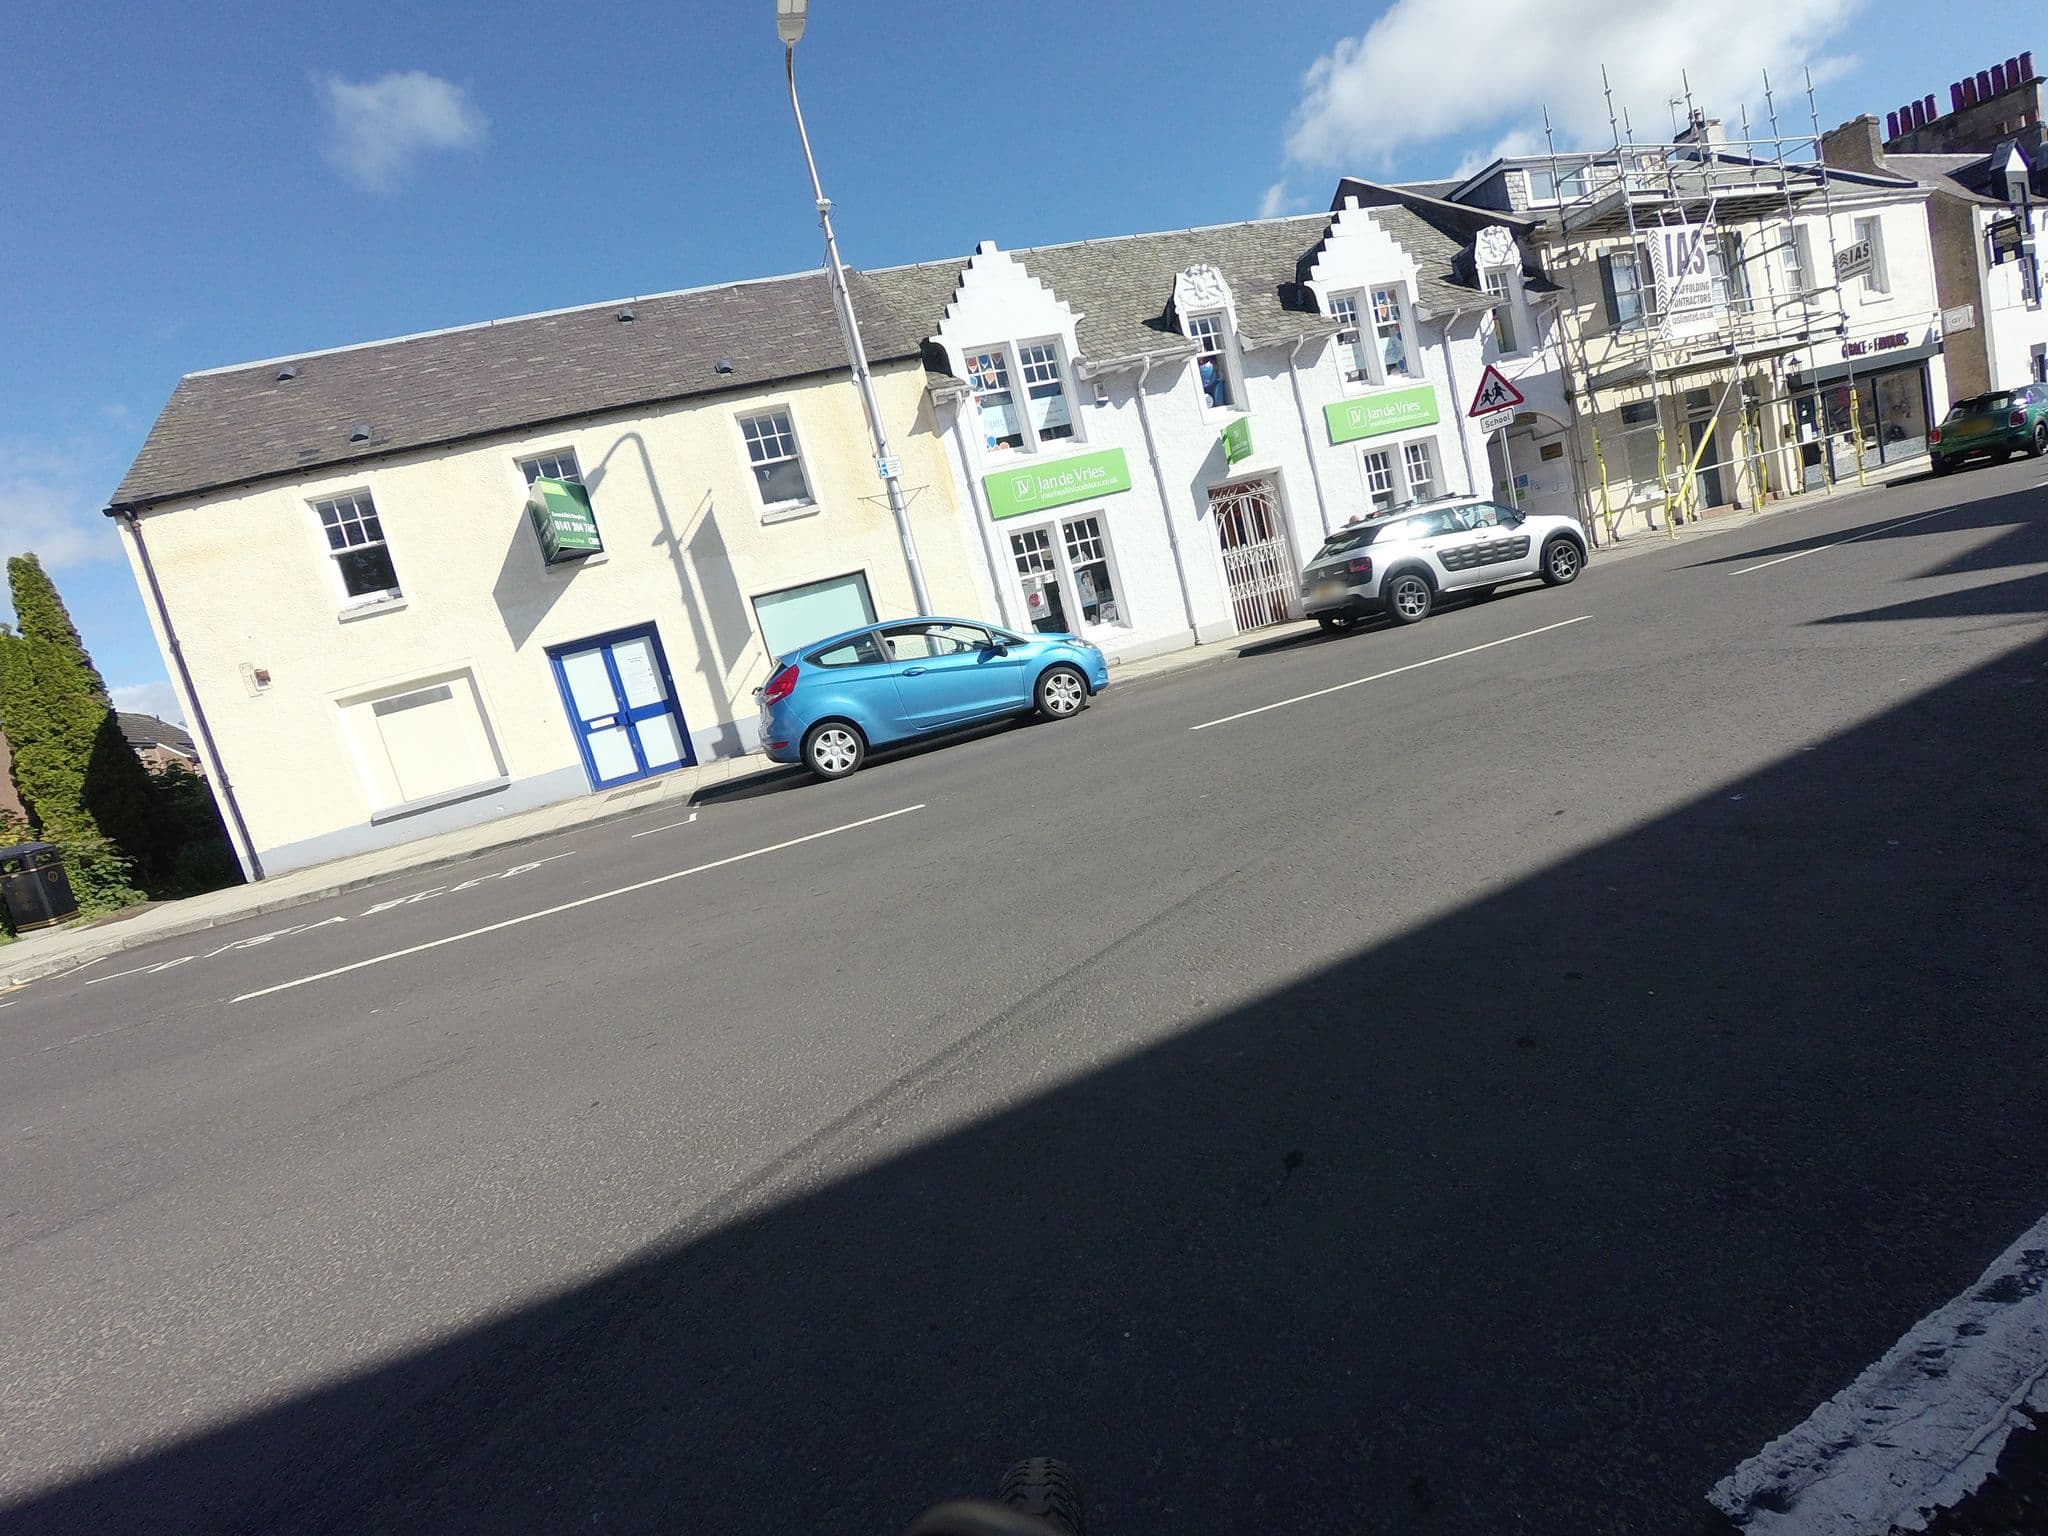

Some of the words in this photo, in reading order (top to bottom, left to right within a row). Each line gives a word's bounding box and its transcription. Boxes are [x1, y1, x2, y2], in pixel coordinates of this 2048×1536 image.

[1665, 229, 1705, 277] IAS
[1850, 242, 1869, 264] IAS
[1671, 292, 1712, 307] ONTRACTORS
[1367, 407, 1383, 423] Jan
[1382, 405, 1396, 417] de
[1395, 400, 1421, 415] Vries
[1484, 413, 1511, 428] School
[1038, 475, 1059, 493] Jan
[1059, 472, 1075, 486] de
[1073, 465, 1106, 482] Vries
[554, 520, 571, 532] 0141
[146, 860, 544, 975] DISABLED
